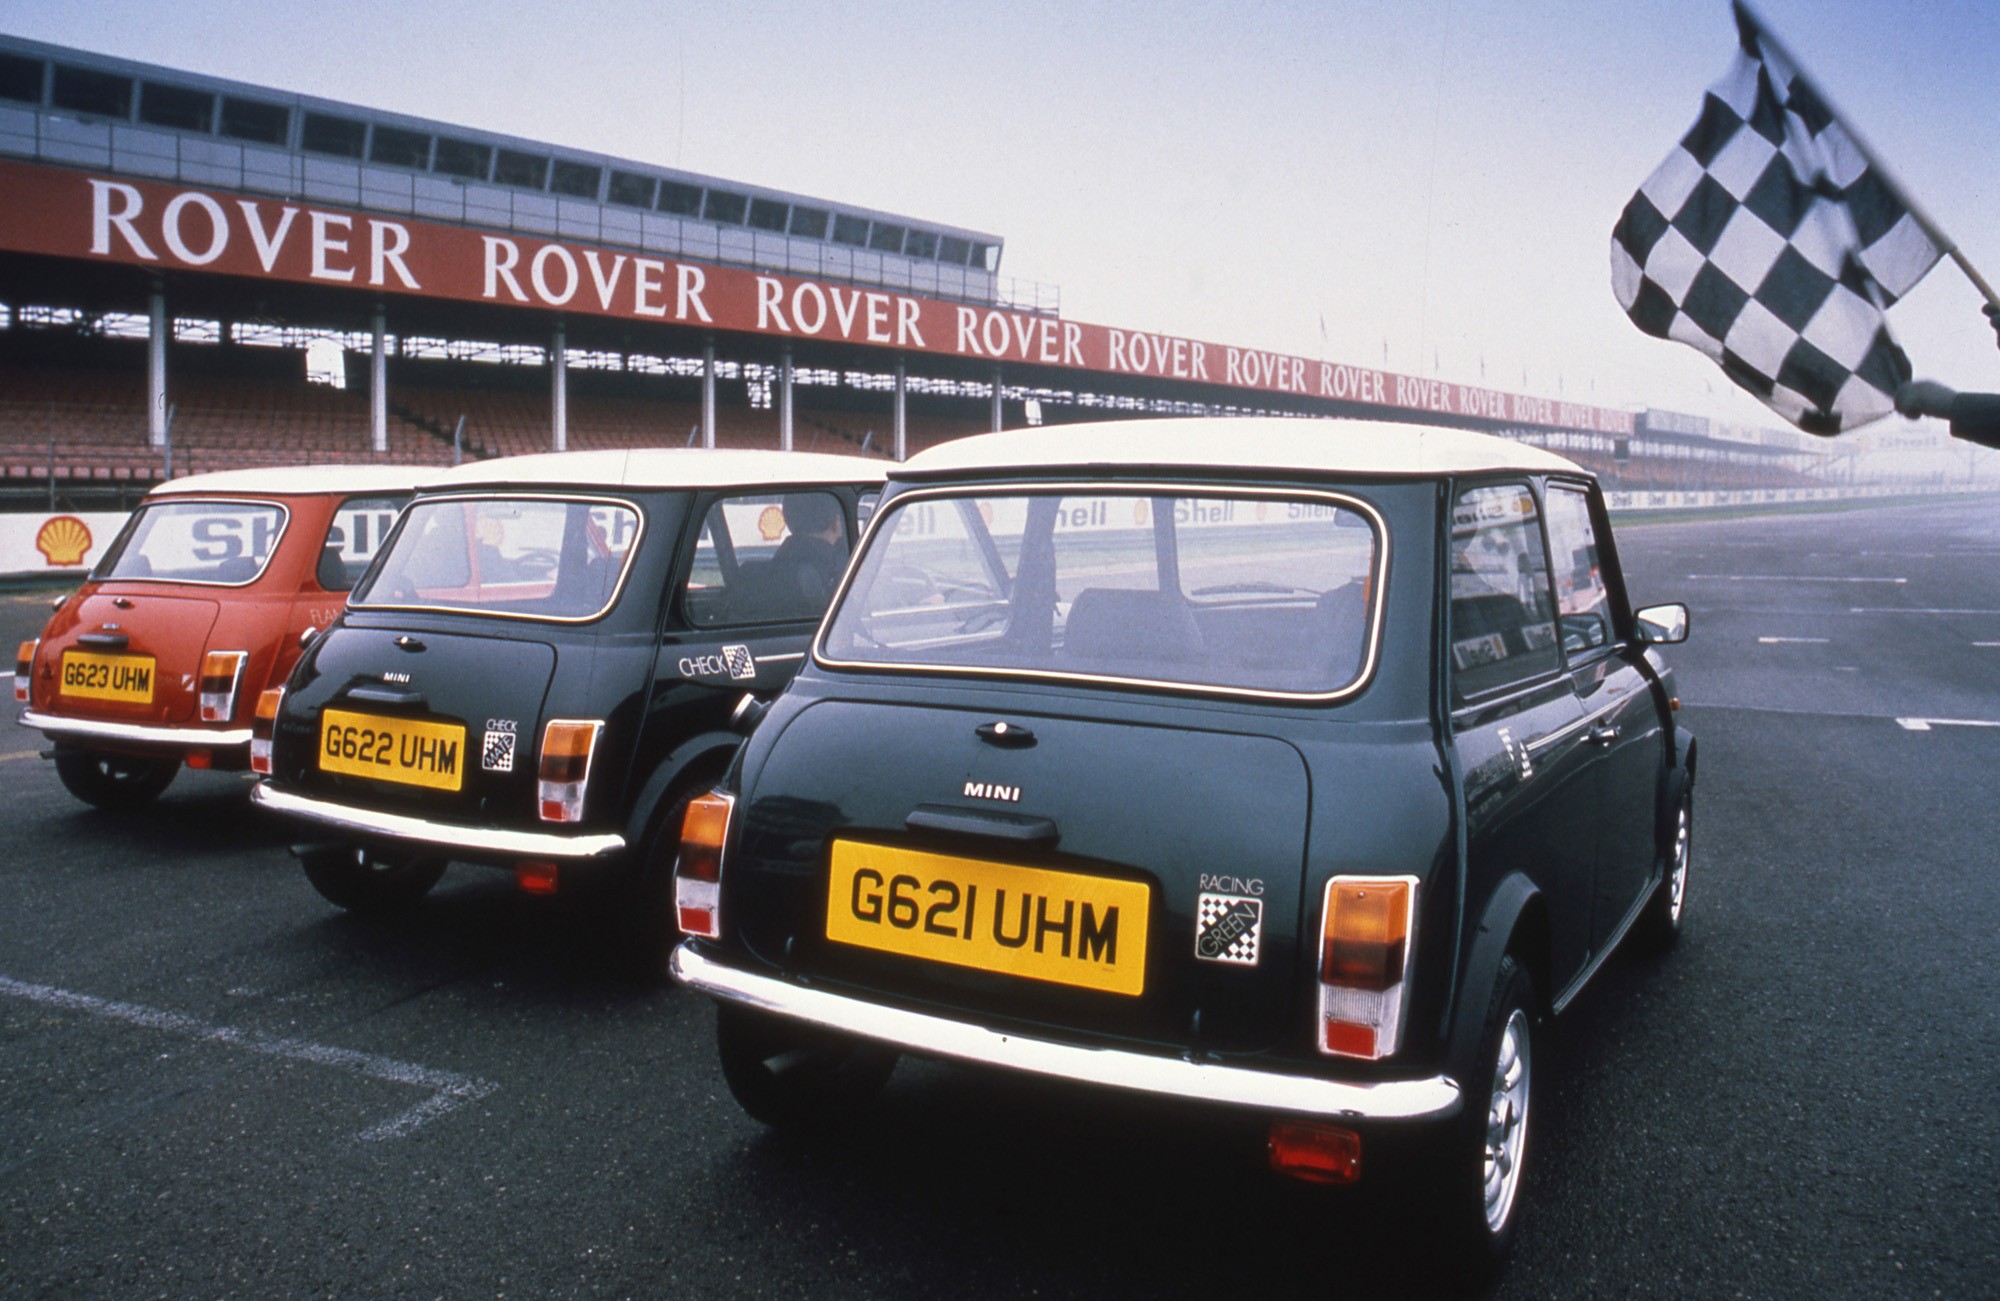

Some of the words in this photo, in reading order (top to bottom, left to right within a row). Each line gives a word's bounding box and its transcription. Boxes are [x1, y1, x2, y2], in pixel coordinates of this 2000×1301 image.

[88, 178, 421, 290] ROVER
[481, 235, 713, 323] ROVER
[756, 276, 926, 348] ROVER
[956, 306, 1085, 366] ROVER
[1108, 329, 1209, 381] ROVER
[1226, 347, 1306, 393] ROVER
[1320, 363, 1385, 403] ROVER
[1396, 376, 1451, 412] ROVER
[1459, 386, 1506, 419] ROVER
[1513, 394, 1552, 425] ROVER
[1175, 498, 1234, 523] Shell
[64, 662, 109, 689] G623
[112, 666, 150, 692] UHM
[383, 672, 410, 683] MINI
[679, 655, 728, 677] CHECK
[486, 718, 518, 732] CHECK
[326, 725, 393, 766] G622
[400, 734, 457, 775] UHM
[964, 782, 1021, 802] MINI
[1200, 873, 1265, 896] RACING
[851, 868, 977, 941] G621
[993, 888, 1119, 965] UHM
[1200, 903, 1256, 956] GREEN
